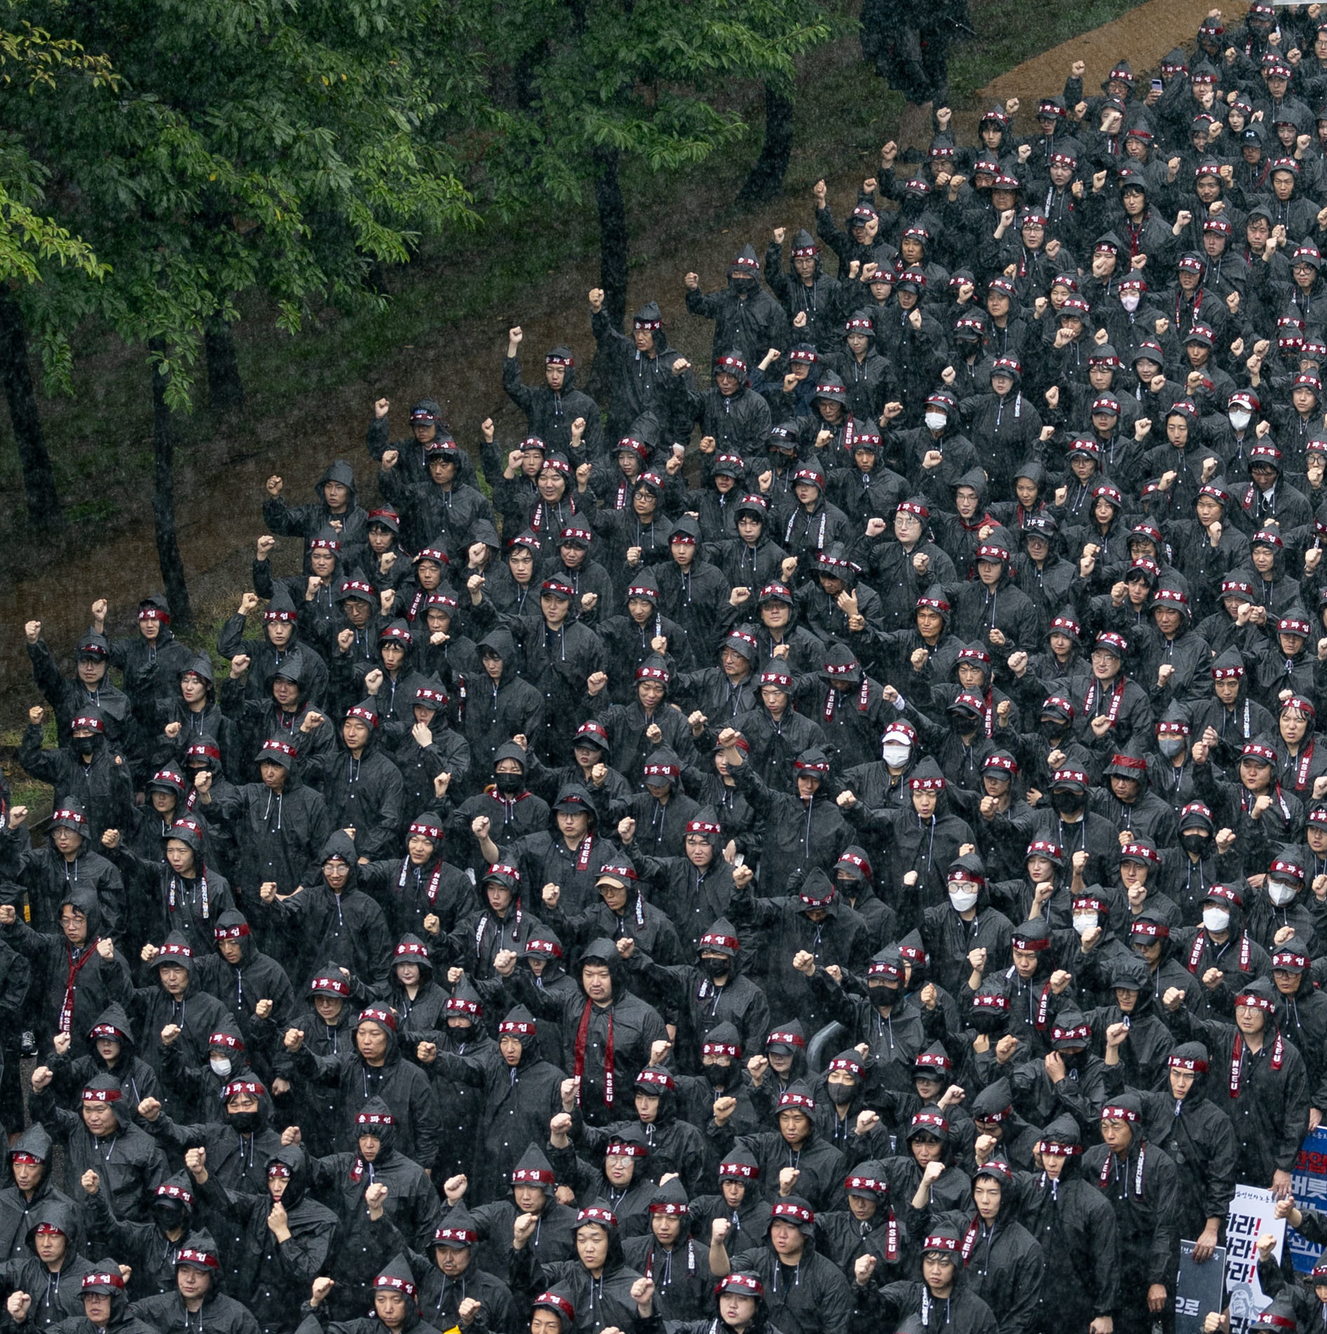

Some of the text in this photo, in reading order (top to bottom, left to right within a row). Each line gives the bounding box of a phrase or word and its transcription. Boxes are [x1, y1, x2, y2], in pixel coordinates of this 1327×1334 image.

[1109, 695, 1121, 721] NSEU
[1300, 756, 1309, 783] NSEU
[428, 873, 440, 898] NSEU
[1190, 939, 1203, 966] NSEU
[1241, 940, 1249, 964] NSEU
[1038, 995, 1046, 1024] NSEU
[209, 1034, 235, 1046] 파업
[1231, 1061, 1239, 1091] NSEU
[888, 1221, 896, 1252] NSEU
[963, 1229, 975, 1259] NSEU
